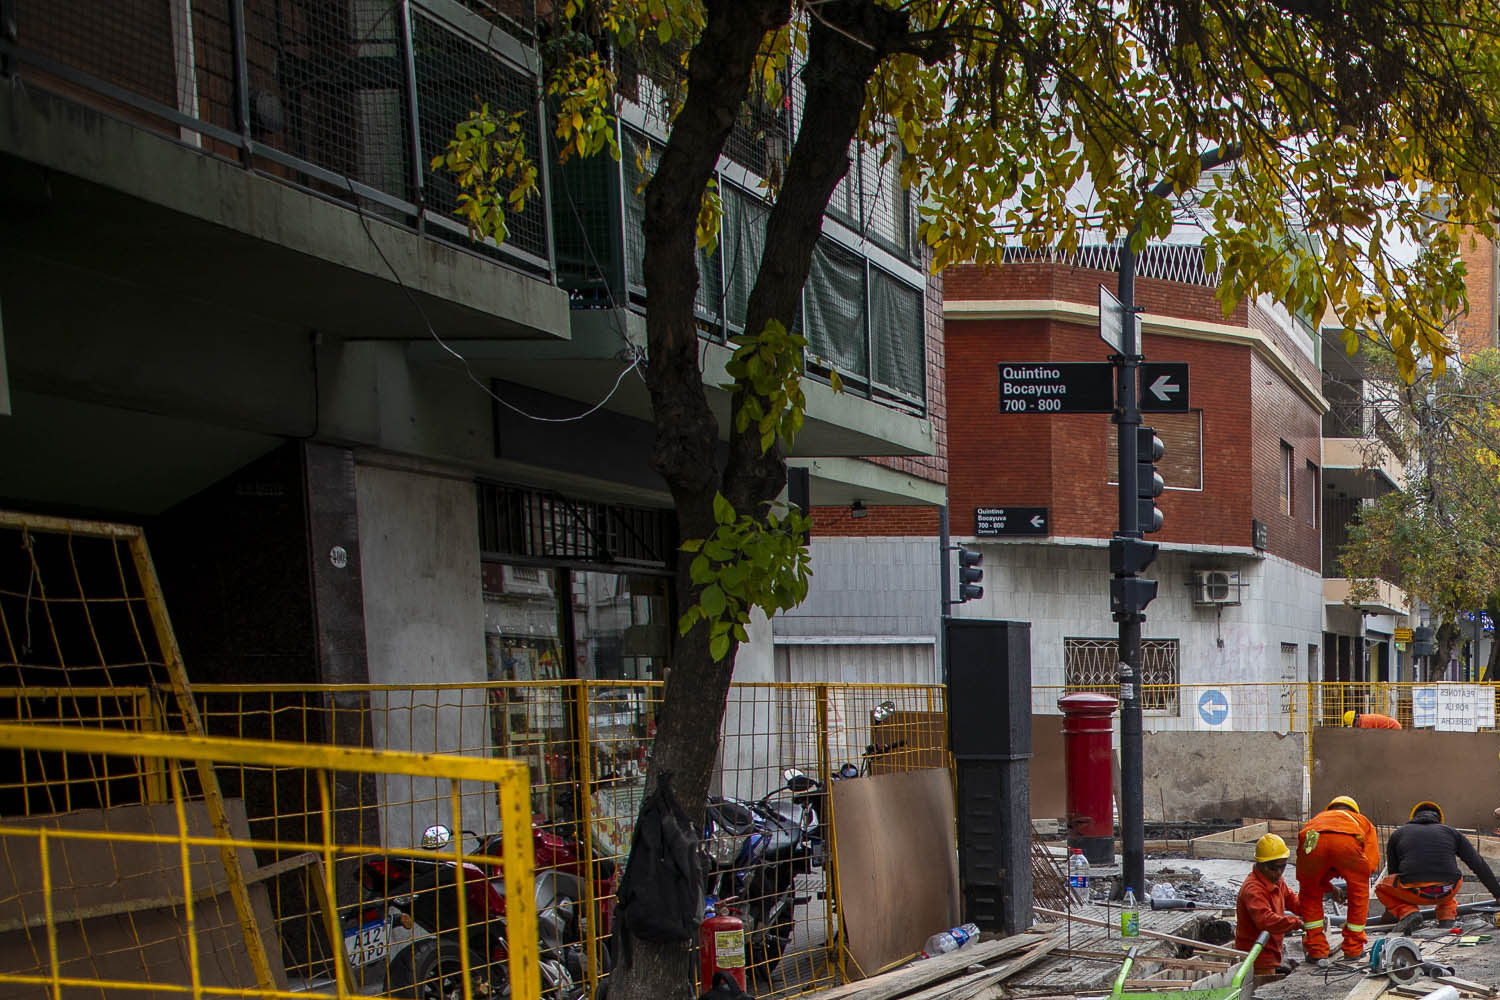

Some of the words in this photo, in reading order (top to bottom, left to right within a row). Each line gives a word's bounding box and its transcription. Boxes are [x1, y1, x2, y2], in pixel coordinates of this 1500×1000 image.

[1002, 367, 1060, 379] Quintino
[1003, 382, 1066, 397] Bocayuva
[1003, 400, 1026, 411] 700
[1038, 399, 1061, 411] 800
[353, 927, 381, 950] A12
